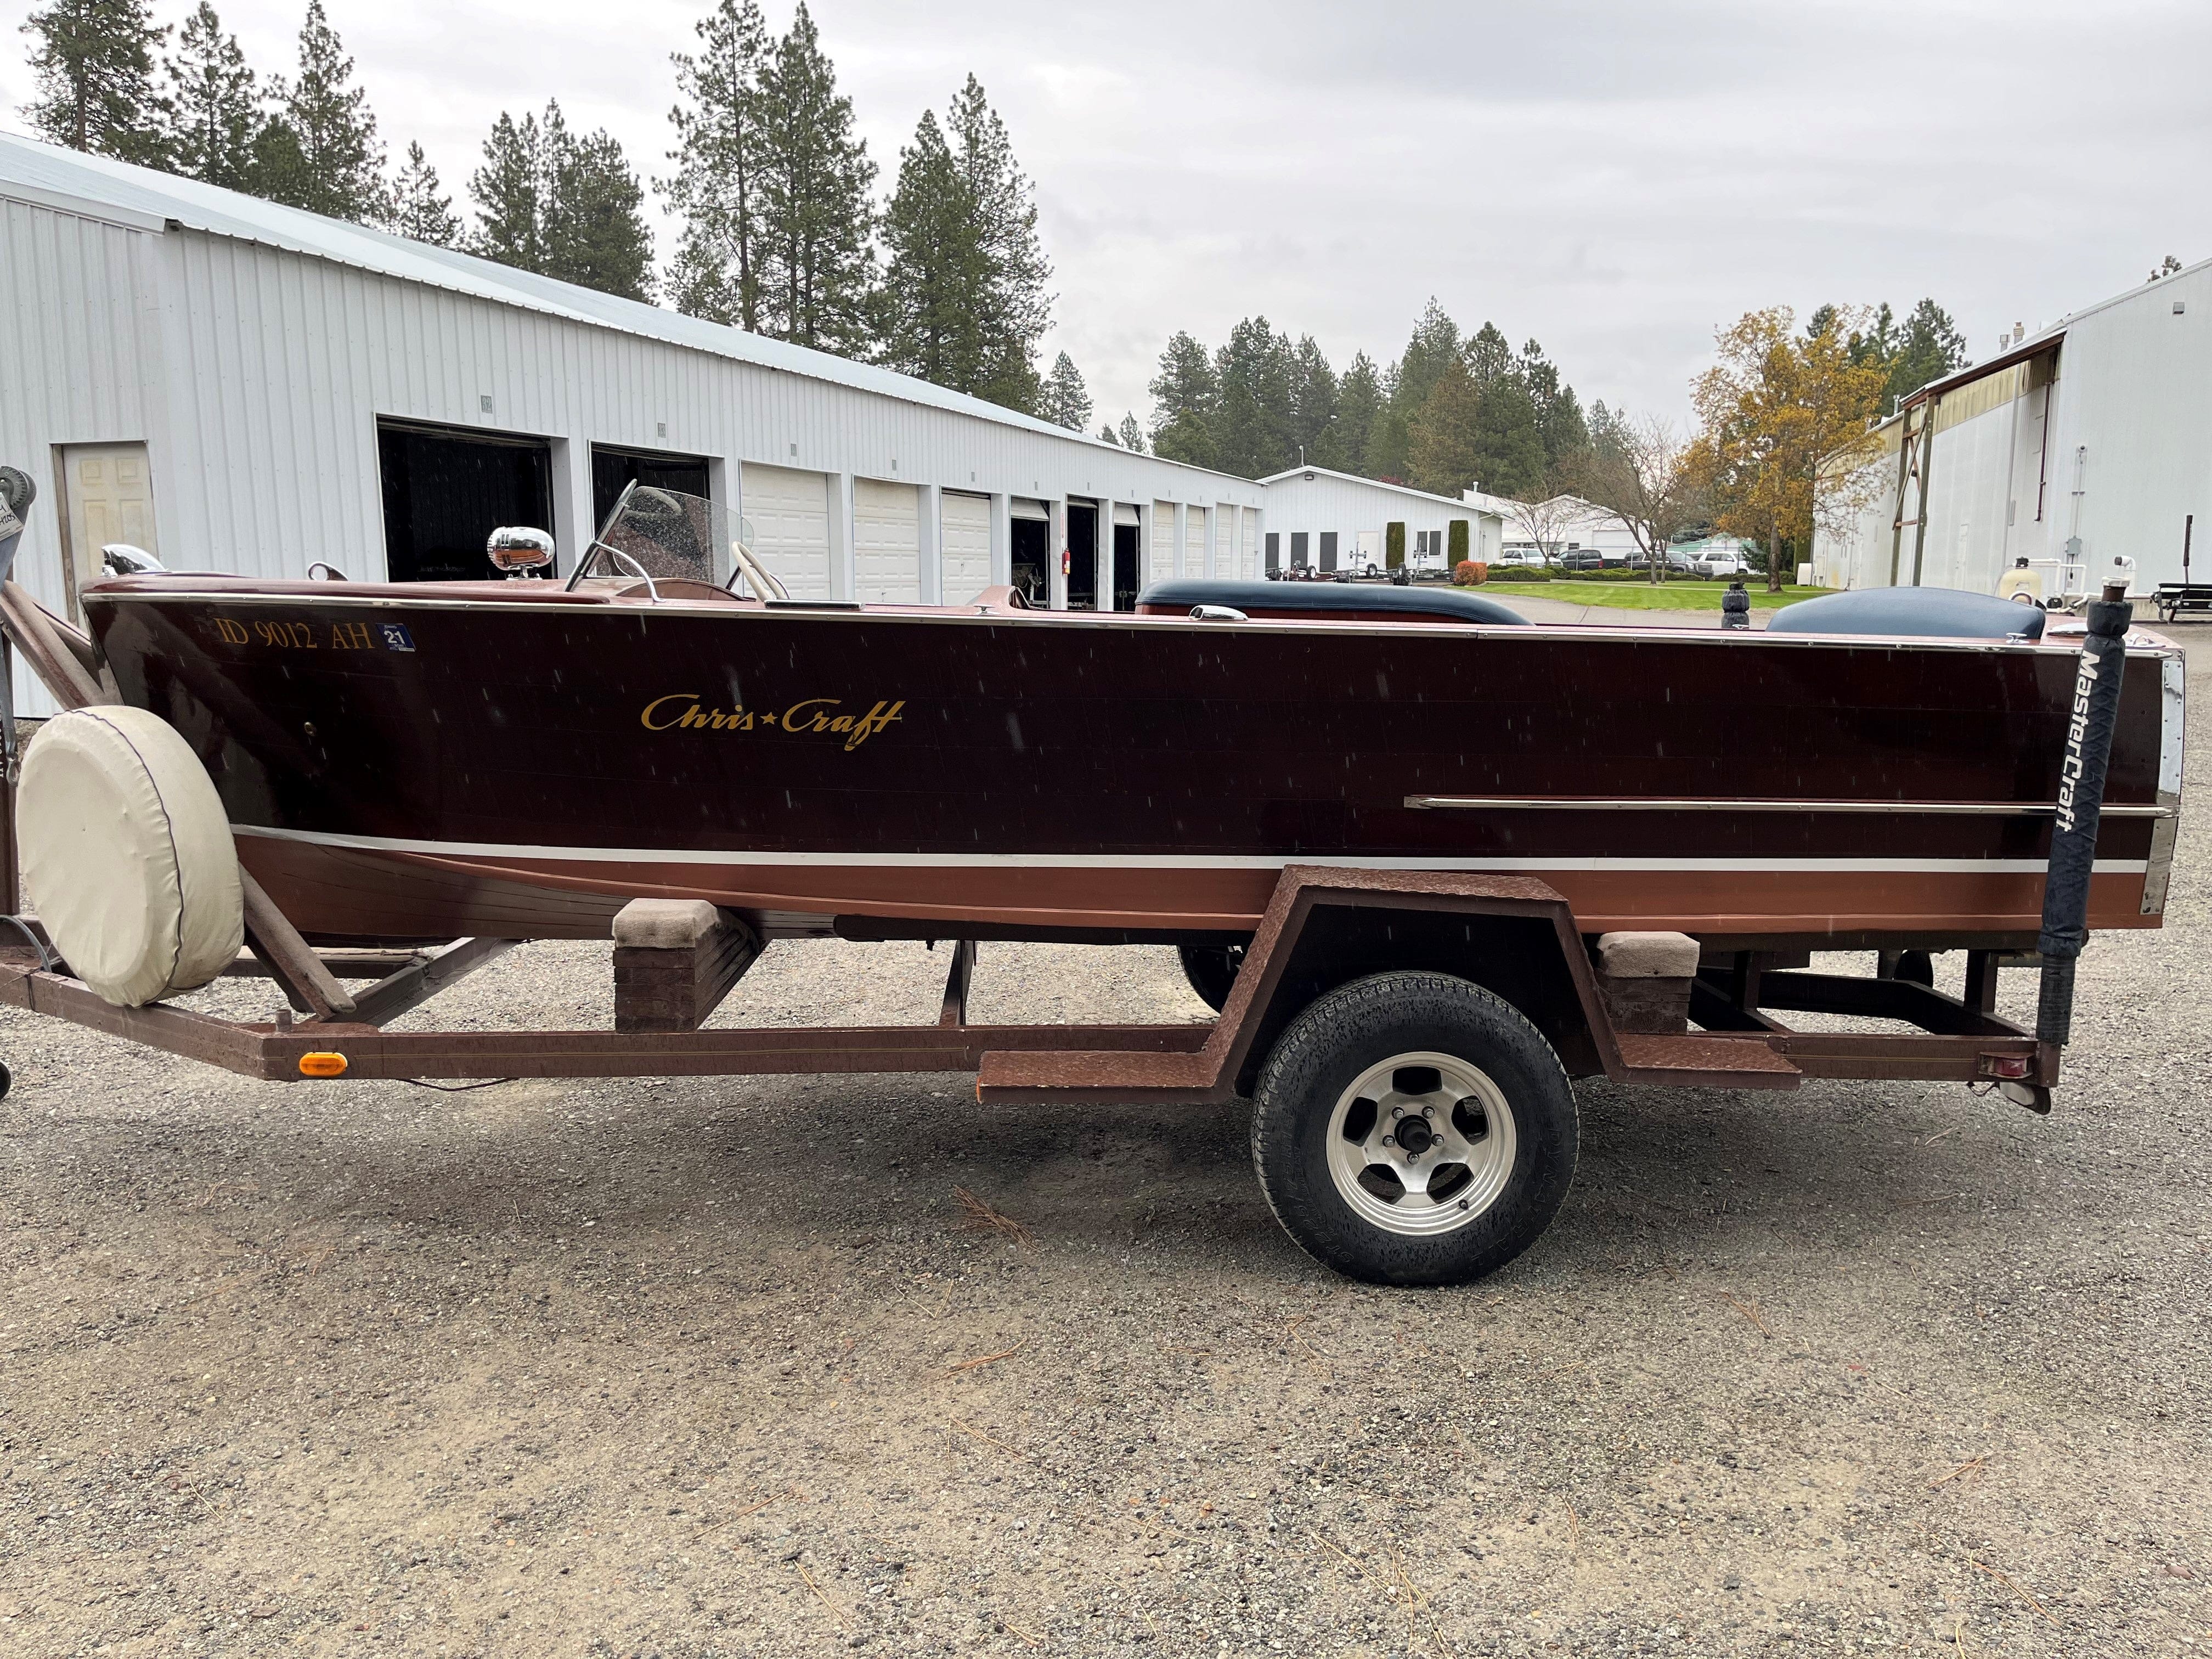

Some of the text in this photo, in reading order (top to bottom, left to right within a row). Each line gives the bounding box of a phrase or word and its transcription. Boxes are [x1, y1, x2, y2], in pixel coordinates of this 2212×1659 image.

[213, 618, 375, 650] ID 9012 AH
[384, 630, 405, 645] 21
[641, 694, 906, 752] Chris Craft
[2056, 650, 2101, 832] MasterCraft
